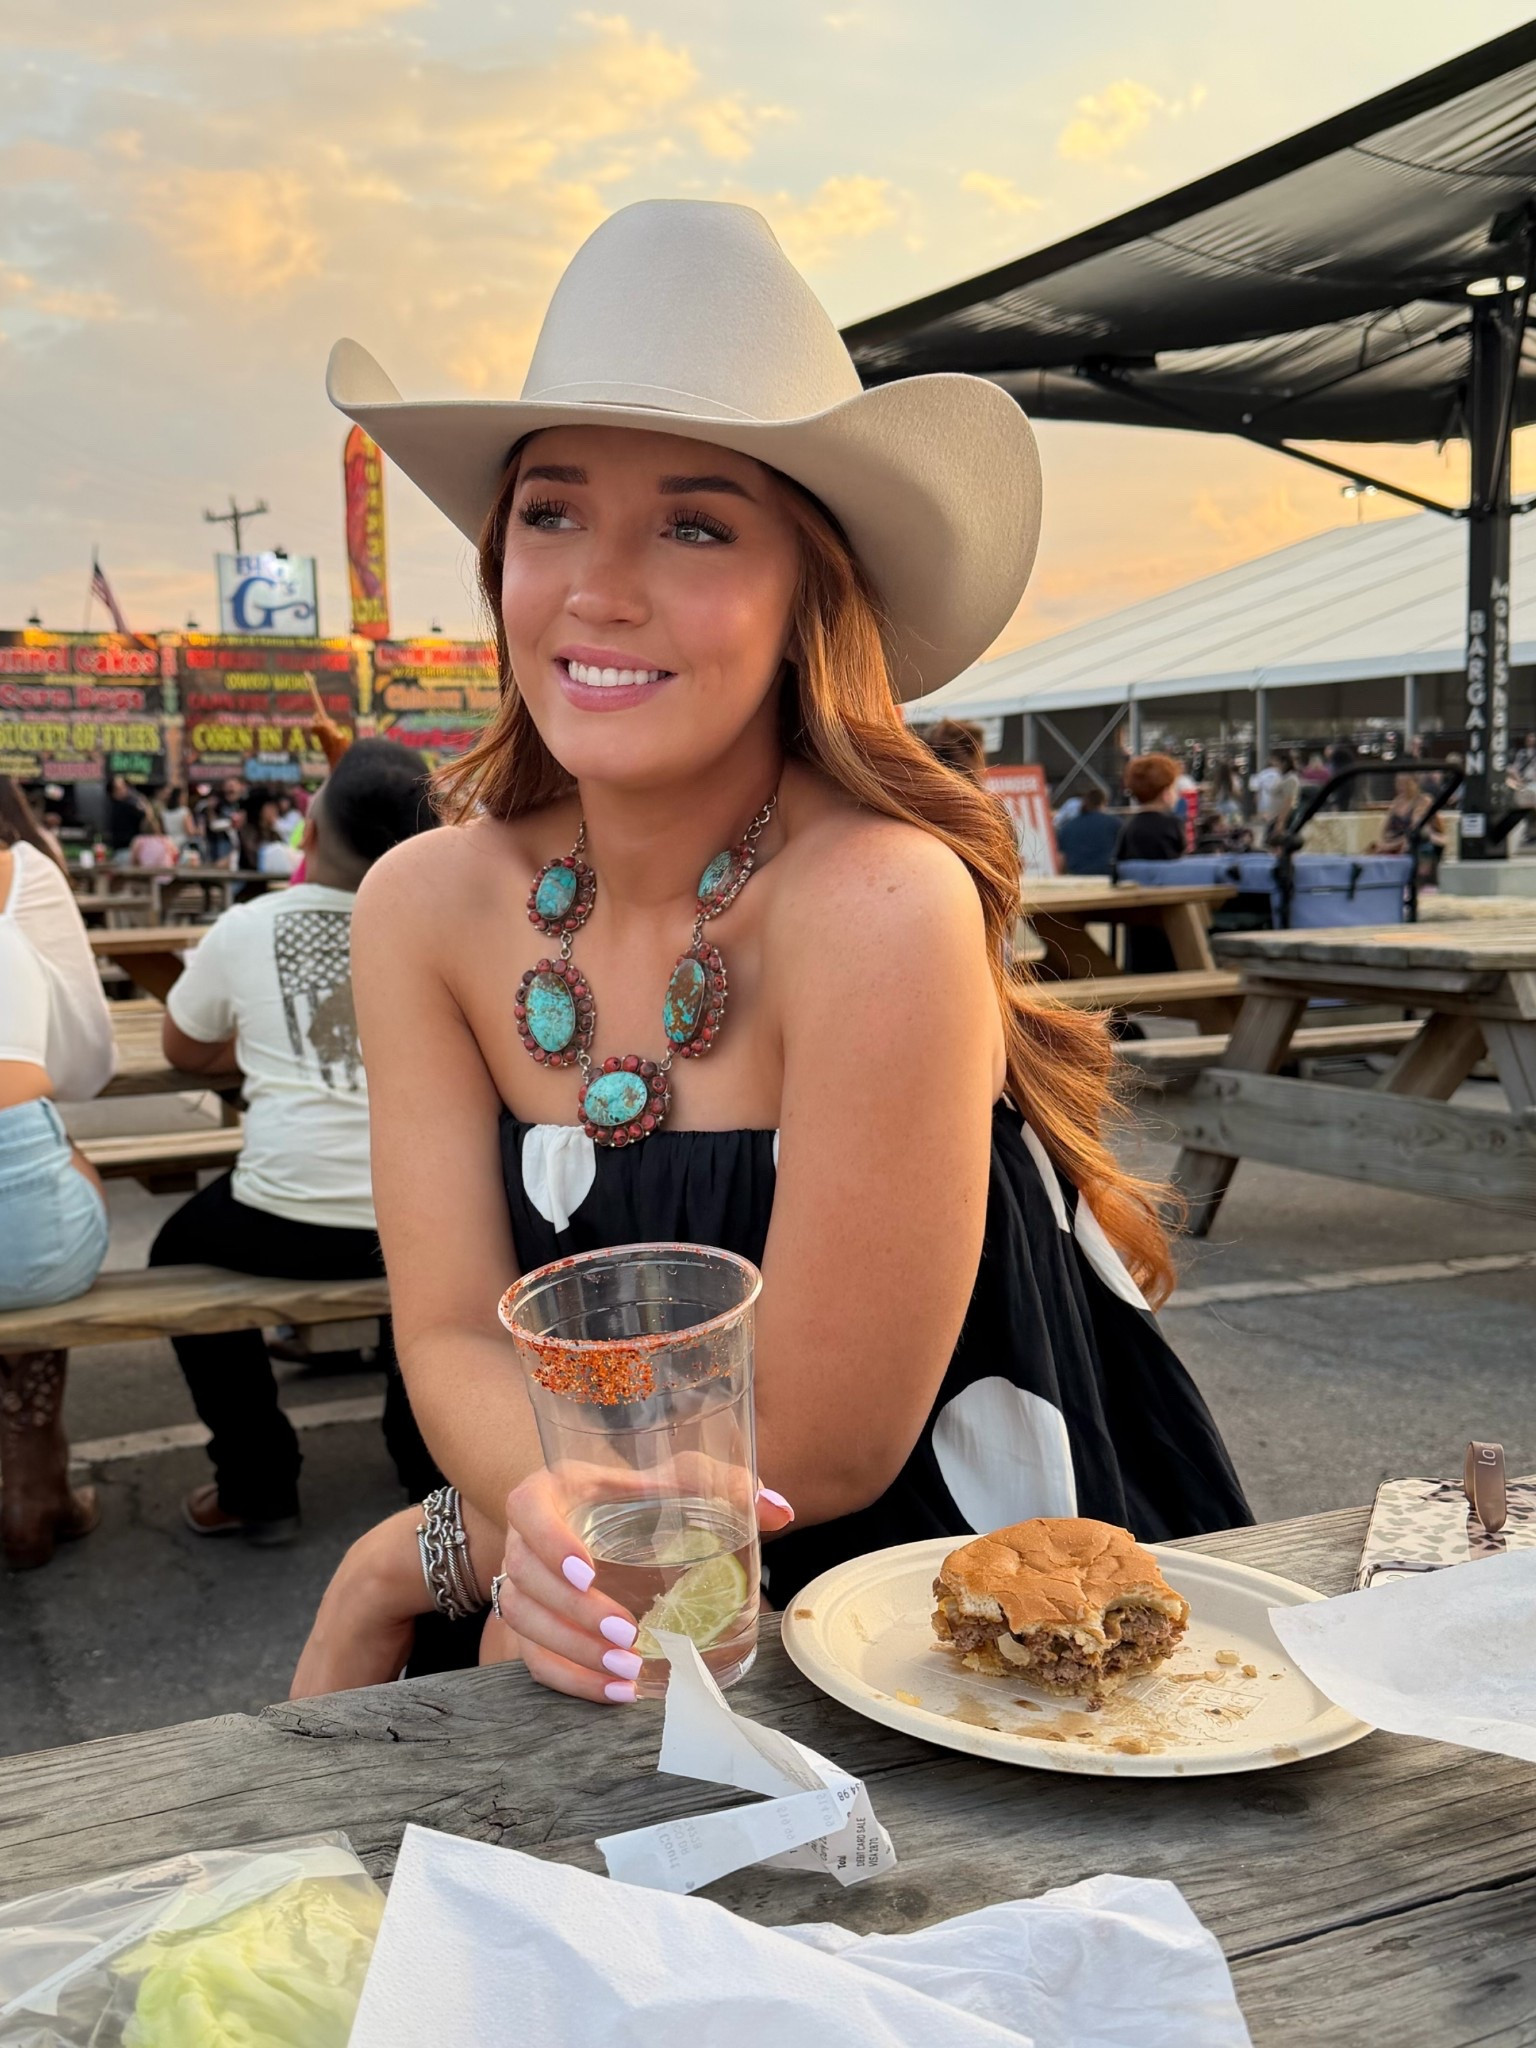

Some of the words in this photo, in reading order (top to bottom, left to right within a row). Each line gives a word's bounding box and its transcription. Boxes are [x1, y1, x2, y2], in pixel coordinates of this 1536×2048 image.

[0, 646, 69, 674] unnel
[74, 643, 158, 675] Cakes
[1465, 610, 1486, 775] BARGAIN
[100, 723, 161, 751] FRIES
[193, 724, 254, 751] CORN
[258, 725, 282, 751] IN
[856, 1817, 866, 1833] SALE
[856, 1834, 866, 1851] CARD
[868, 1853, 878, 1867] VISA
